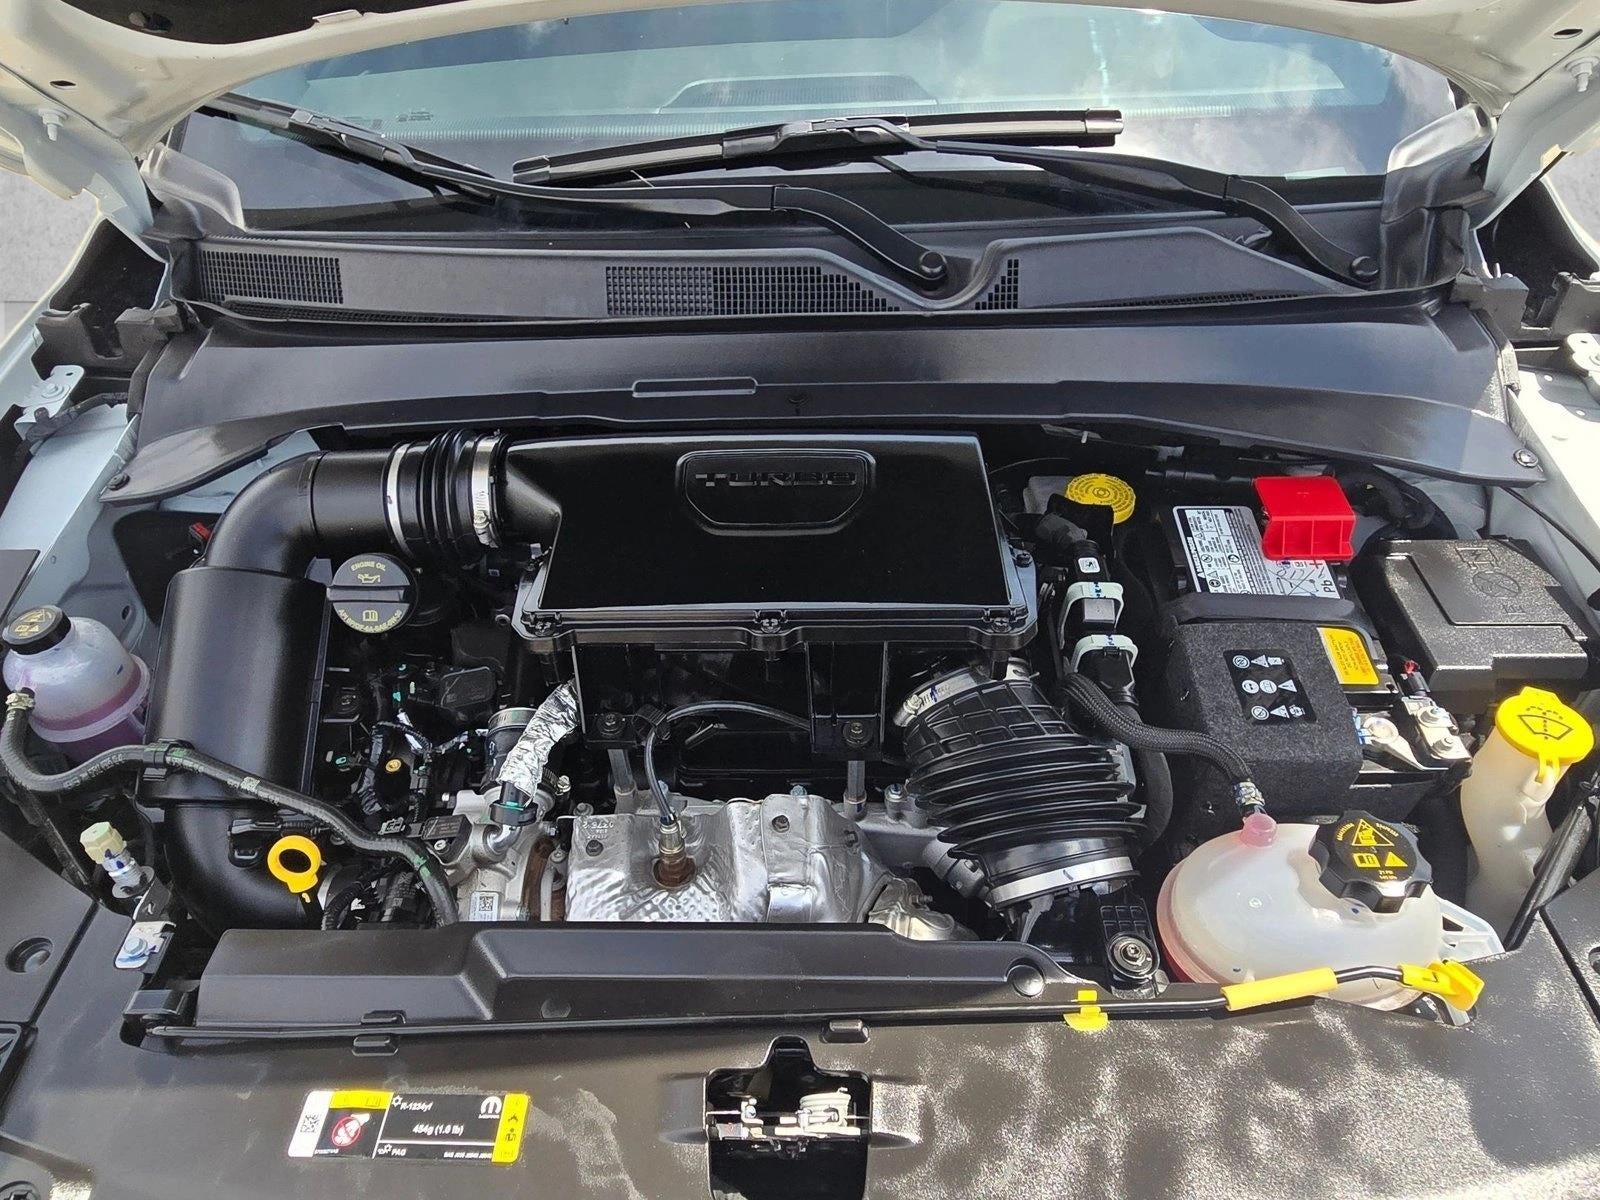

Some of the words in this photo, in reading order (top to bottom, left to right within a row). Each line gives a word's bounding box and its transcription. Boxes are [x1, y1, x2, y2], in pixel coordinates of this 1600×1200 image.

[695, 472, 857, 487] TURBO
[351, 561, 375, 572] ENGINE
[376, 562, 386, 572] OIL
[1321, 579, 1335, 593] Pb
